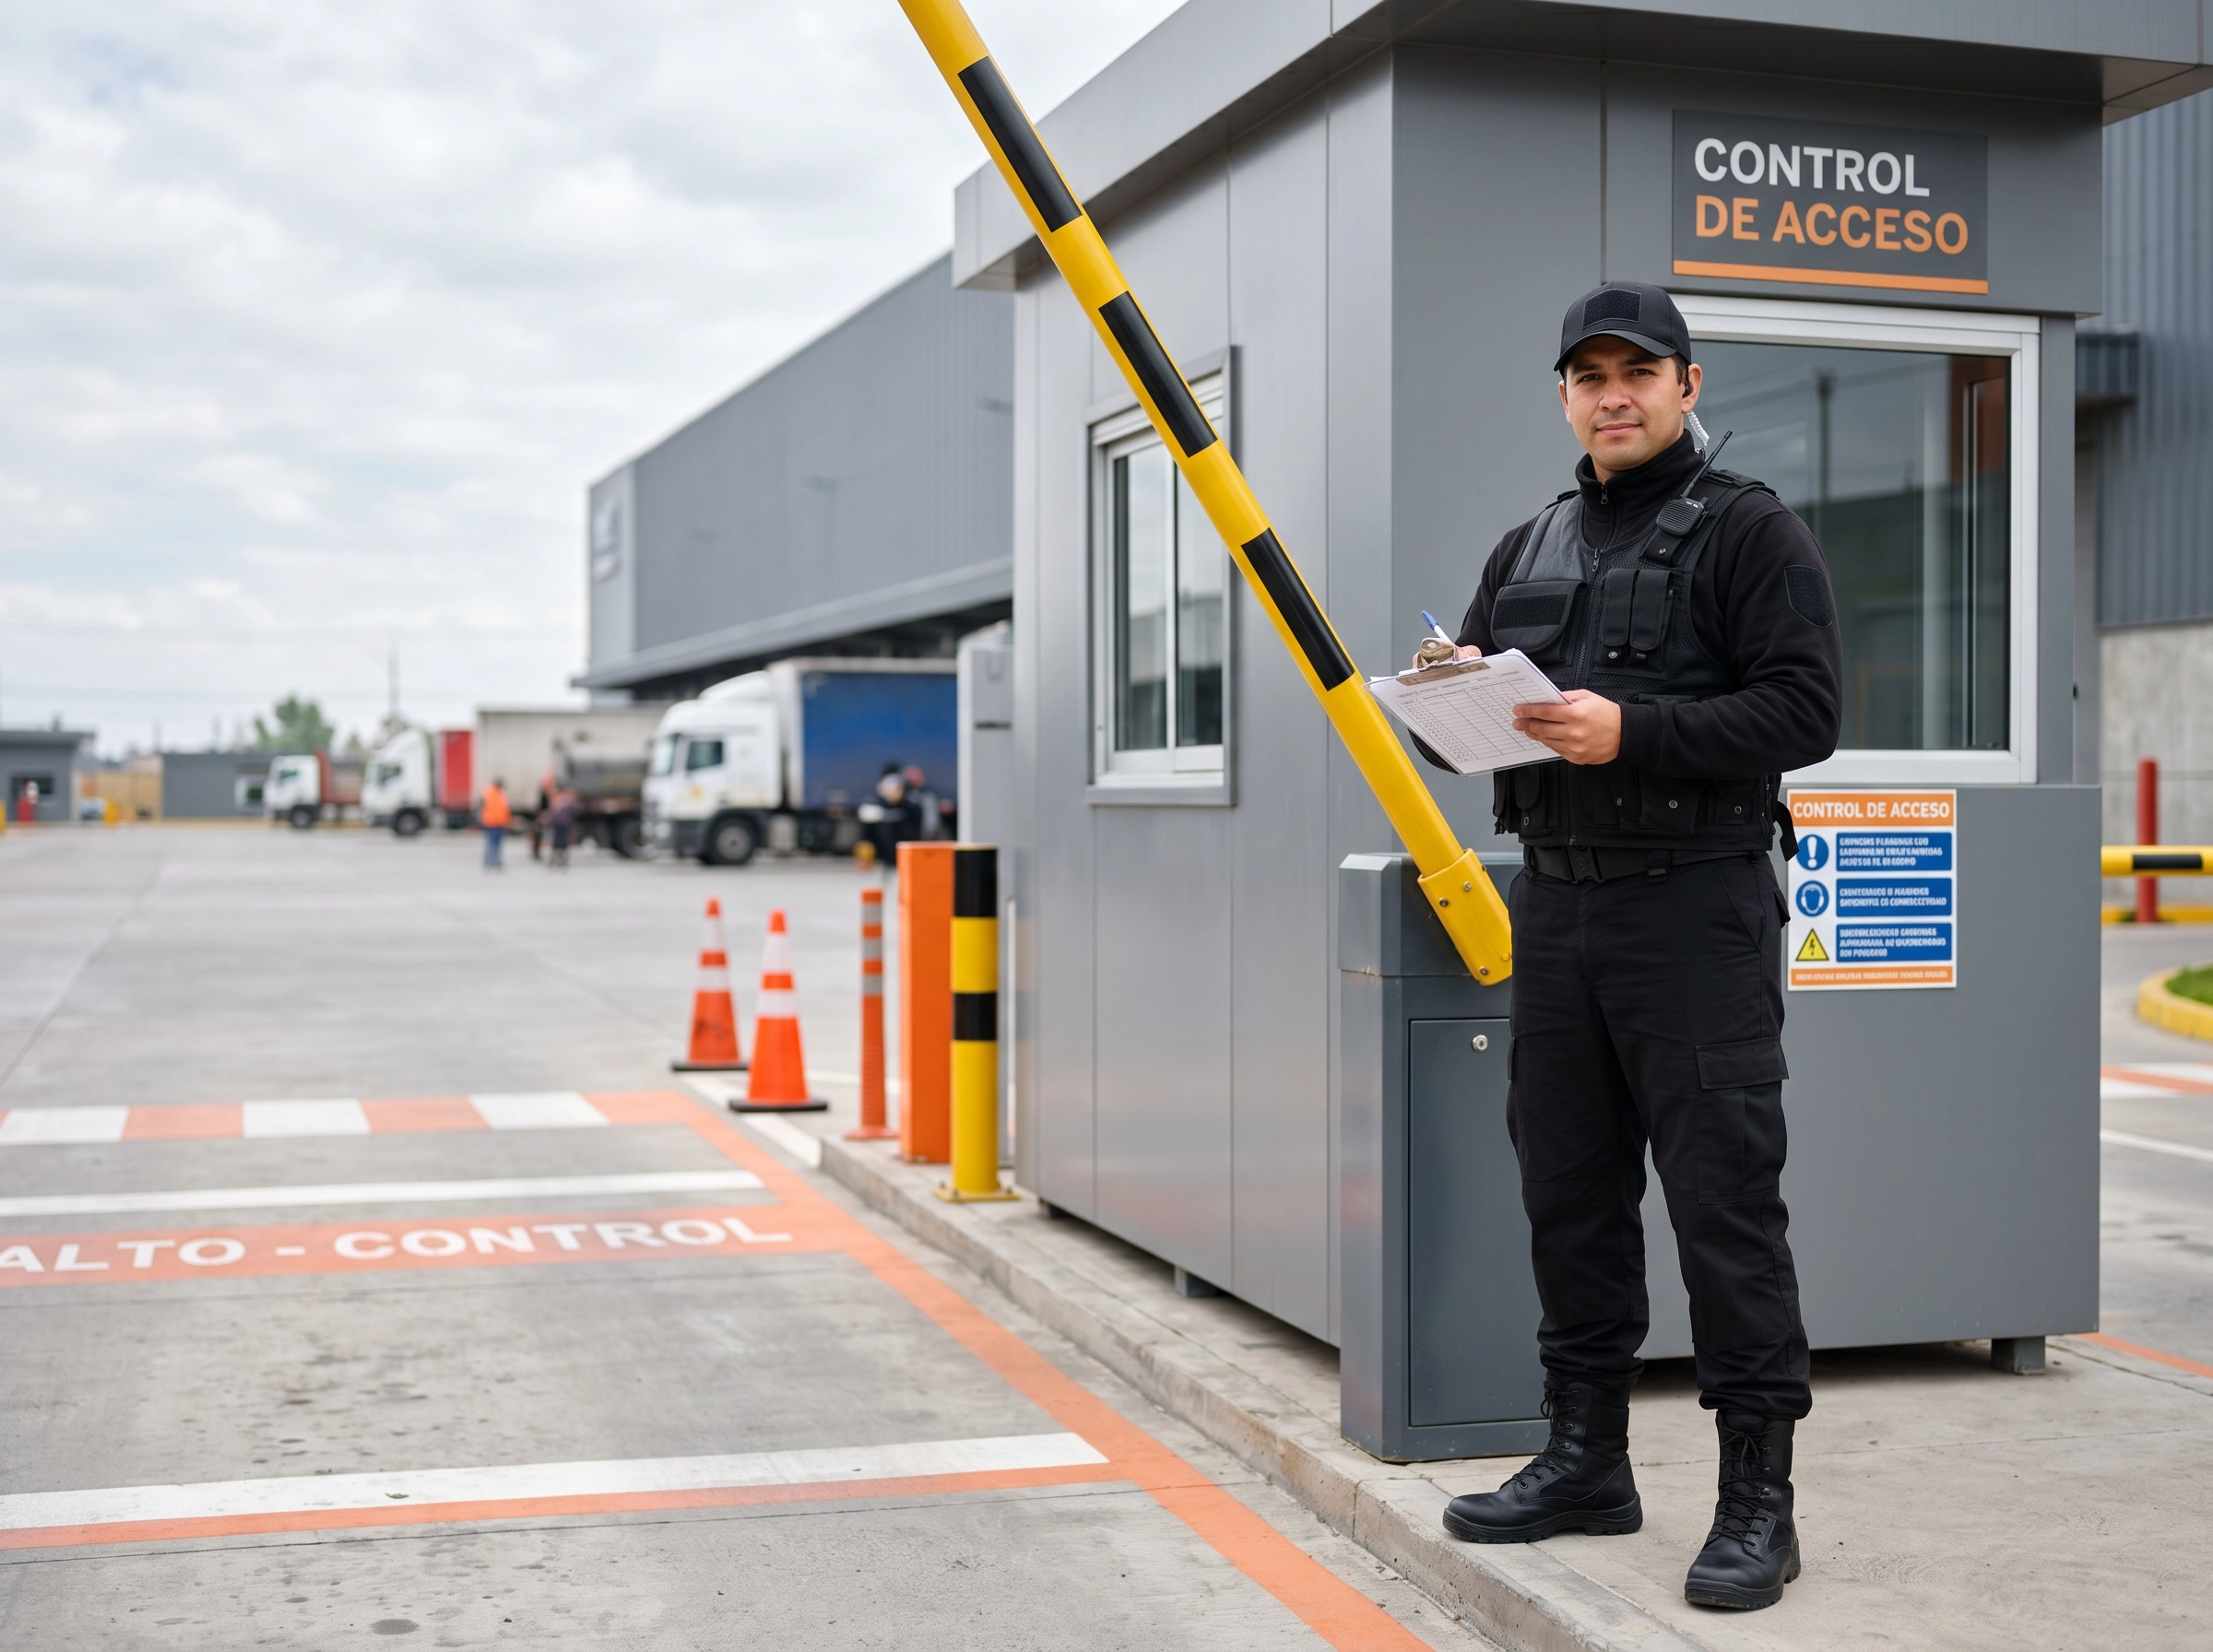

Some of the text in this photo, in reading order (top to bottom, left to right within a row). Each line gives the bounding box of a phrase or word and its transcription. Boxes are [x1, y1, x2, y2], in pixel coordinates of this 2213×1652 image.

[1695, 137, 1930, 197] CONTROL
[1696, 195, 1969, 255] DE ACCESO
[1793, 801, 1950, 819] CONTROL DE ACCESO
[0, 1237, 246, 1273] ALTO
[333, 1217, 793, 1259] CONTROL
